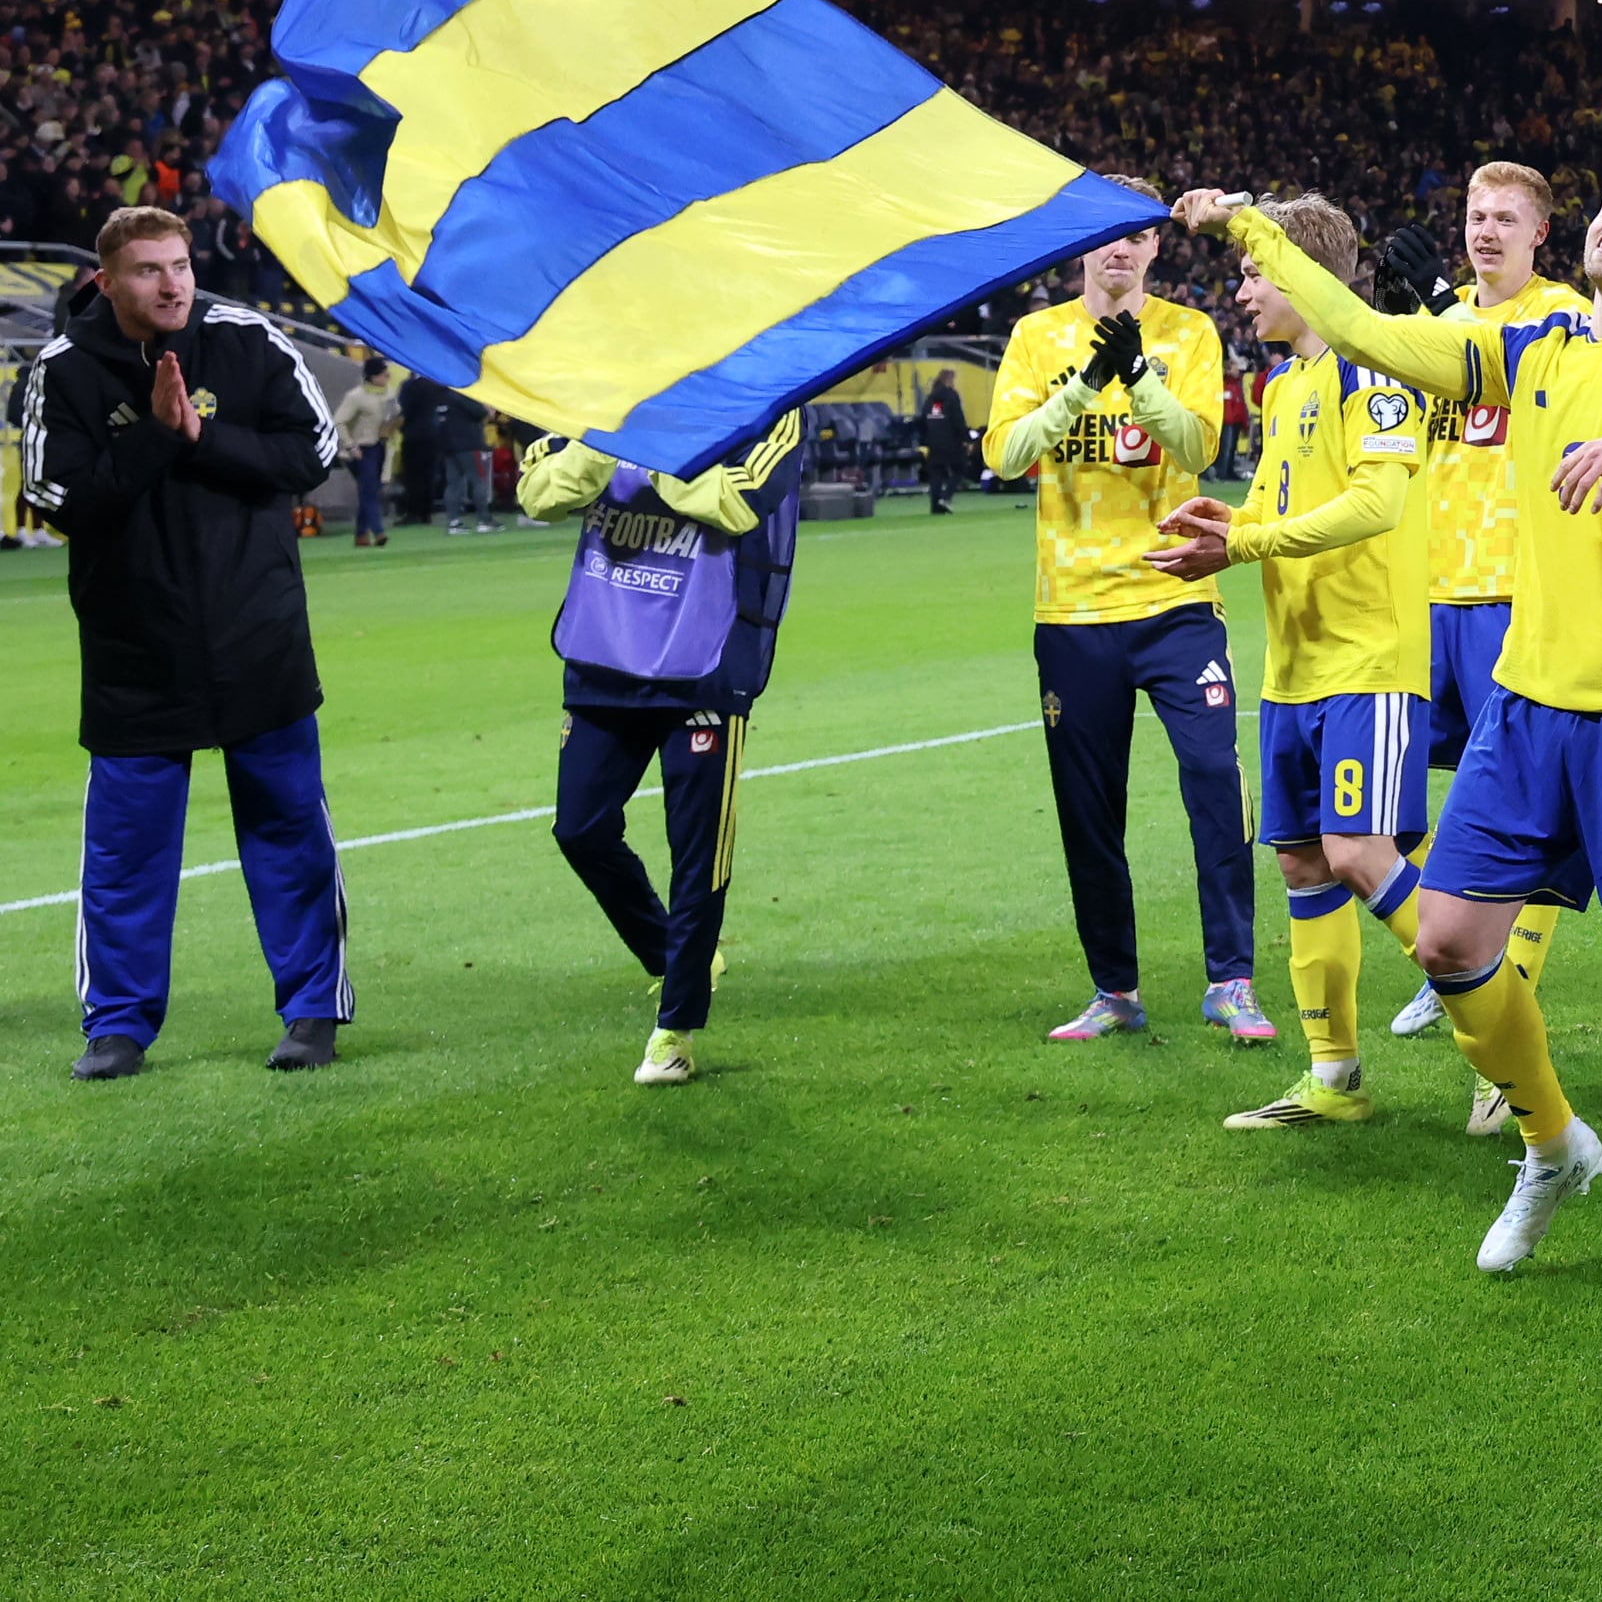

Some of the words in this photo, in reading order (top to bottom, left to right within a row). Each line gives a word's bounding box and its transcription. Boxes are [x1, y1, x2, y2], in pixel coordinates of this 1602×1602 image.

[1054, 439, 1110, 463] SPEL
[1278, 460, 1290, 515] 8
[611, 566, 684, 592] RESPECT
[1333, 758, 1369, 818] 8
[1510, 926, 1543, 944] VERIGE
